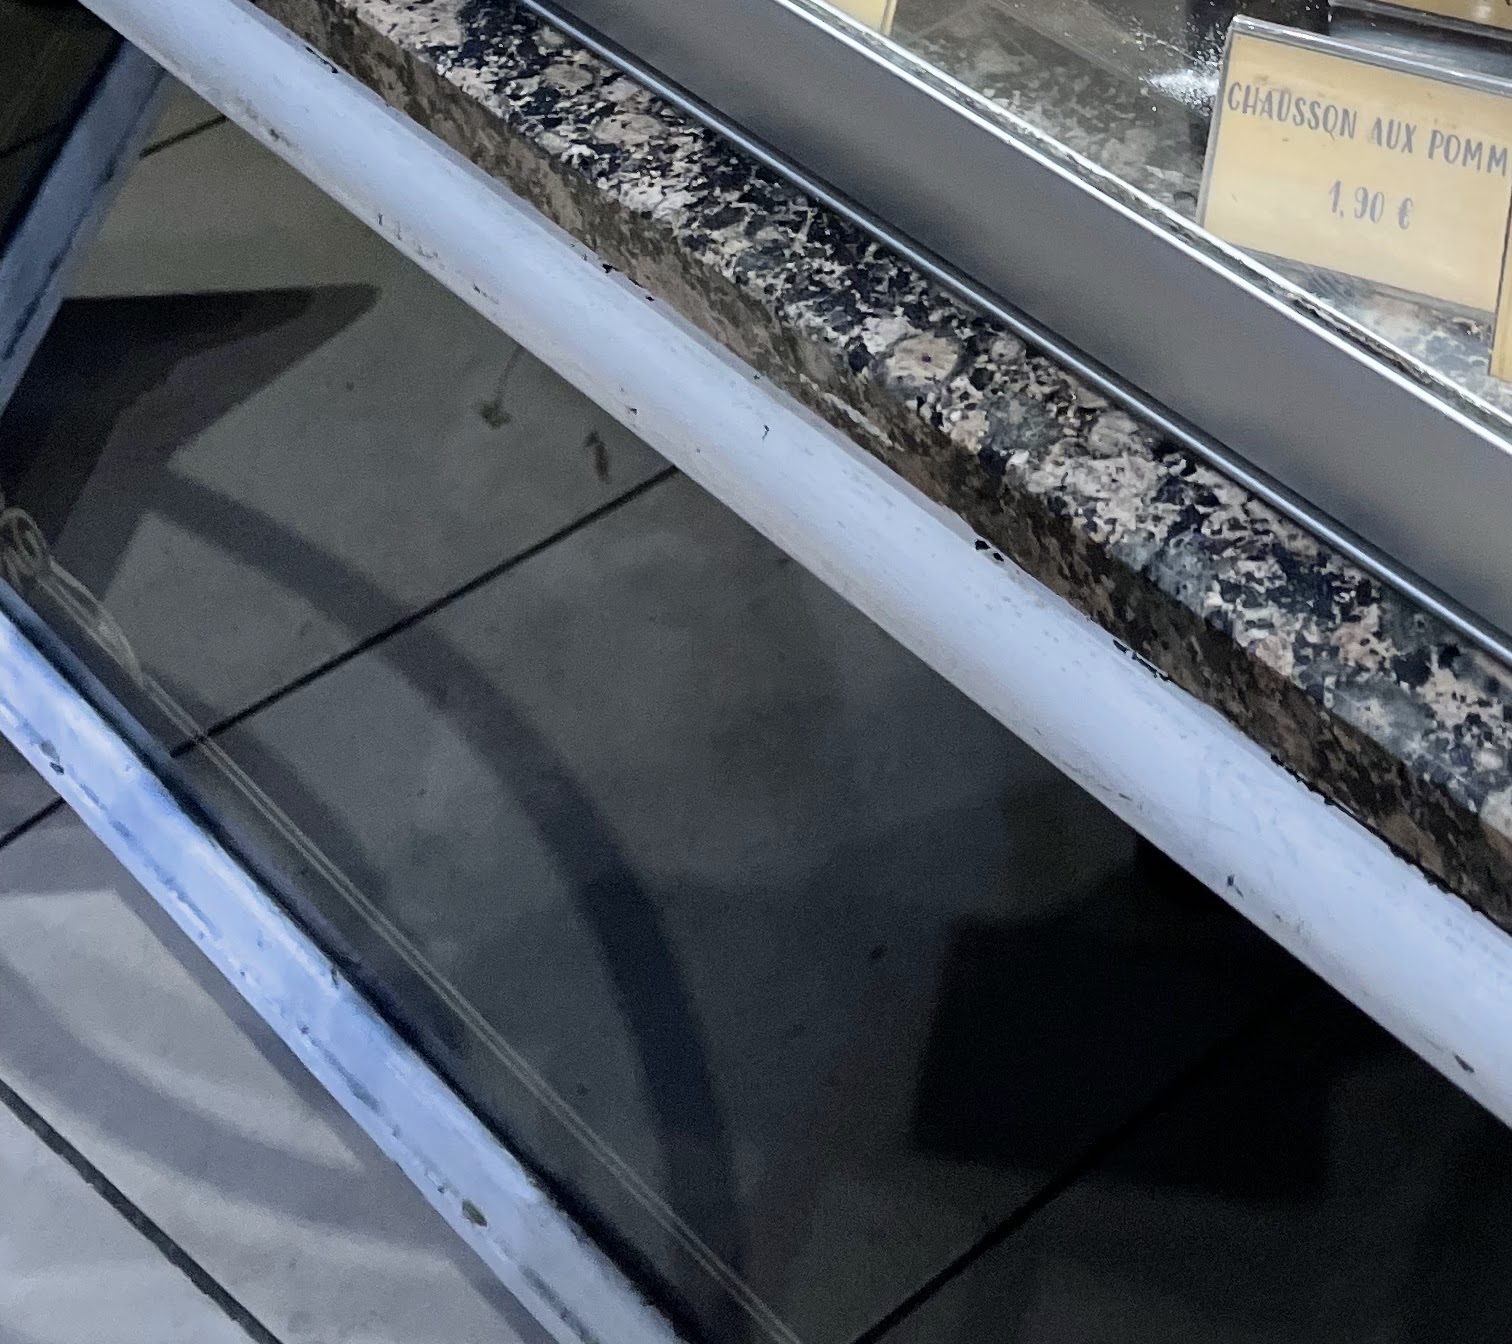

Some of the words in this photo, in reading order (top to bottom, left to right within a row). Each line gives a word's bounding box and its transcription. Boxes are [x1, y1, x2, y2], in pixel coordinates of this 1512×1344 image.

[1226, 81, 1358, 142] CHAUSSON
[1369, 116, 1418, 154] AUX
[1397, 197, 1414, 230] €
